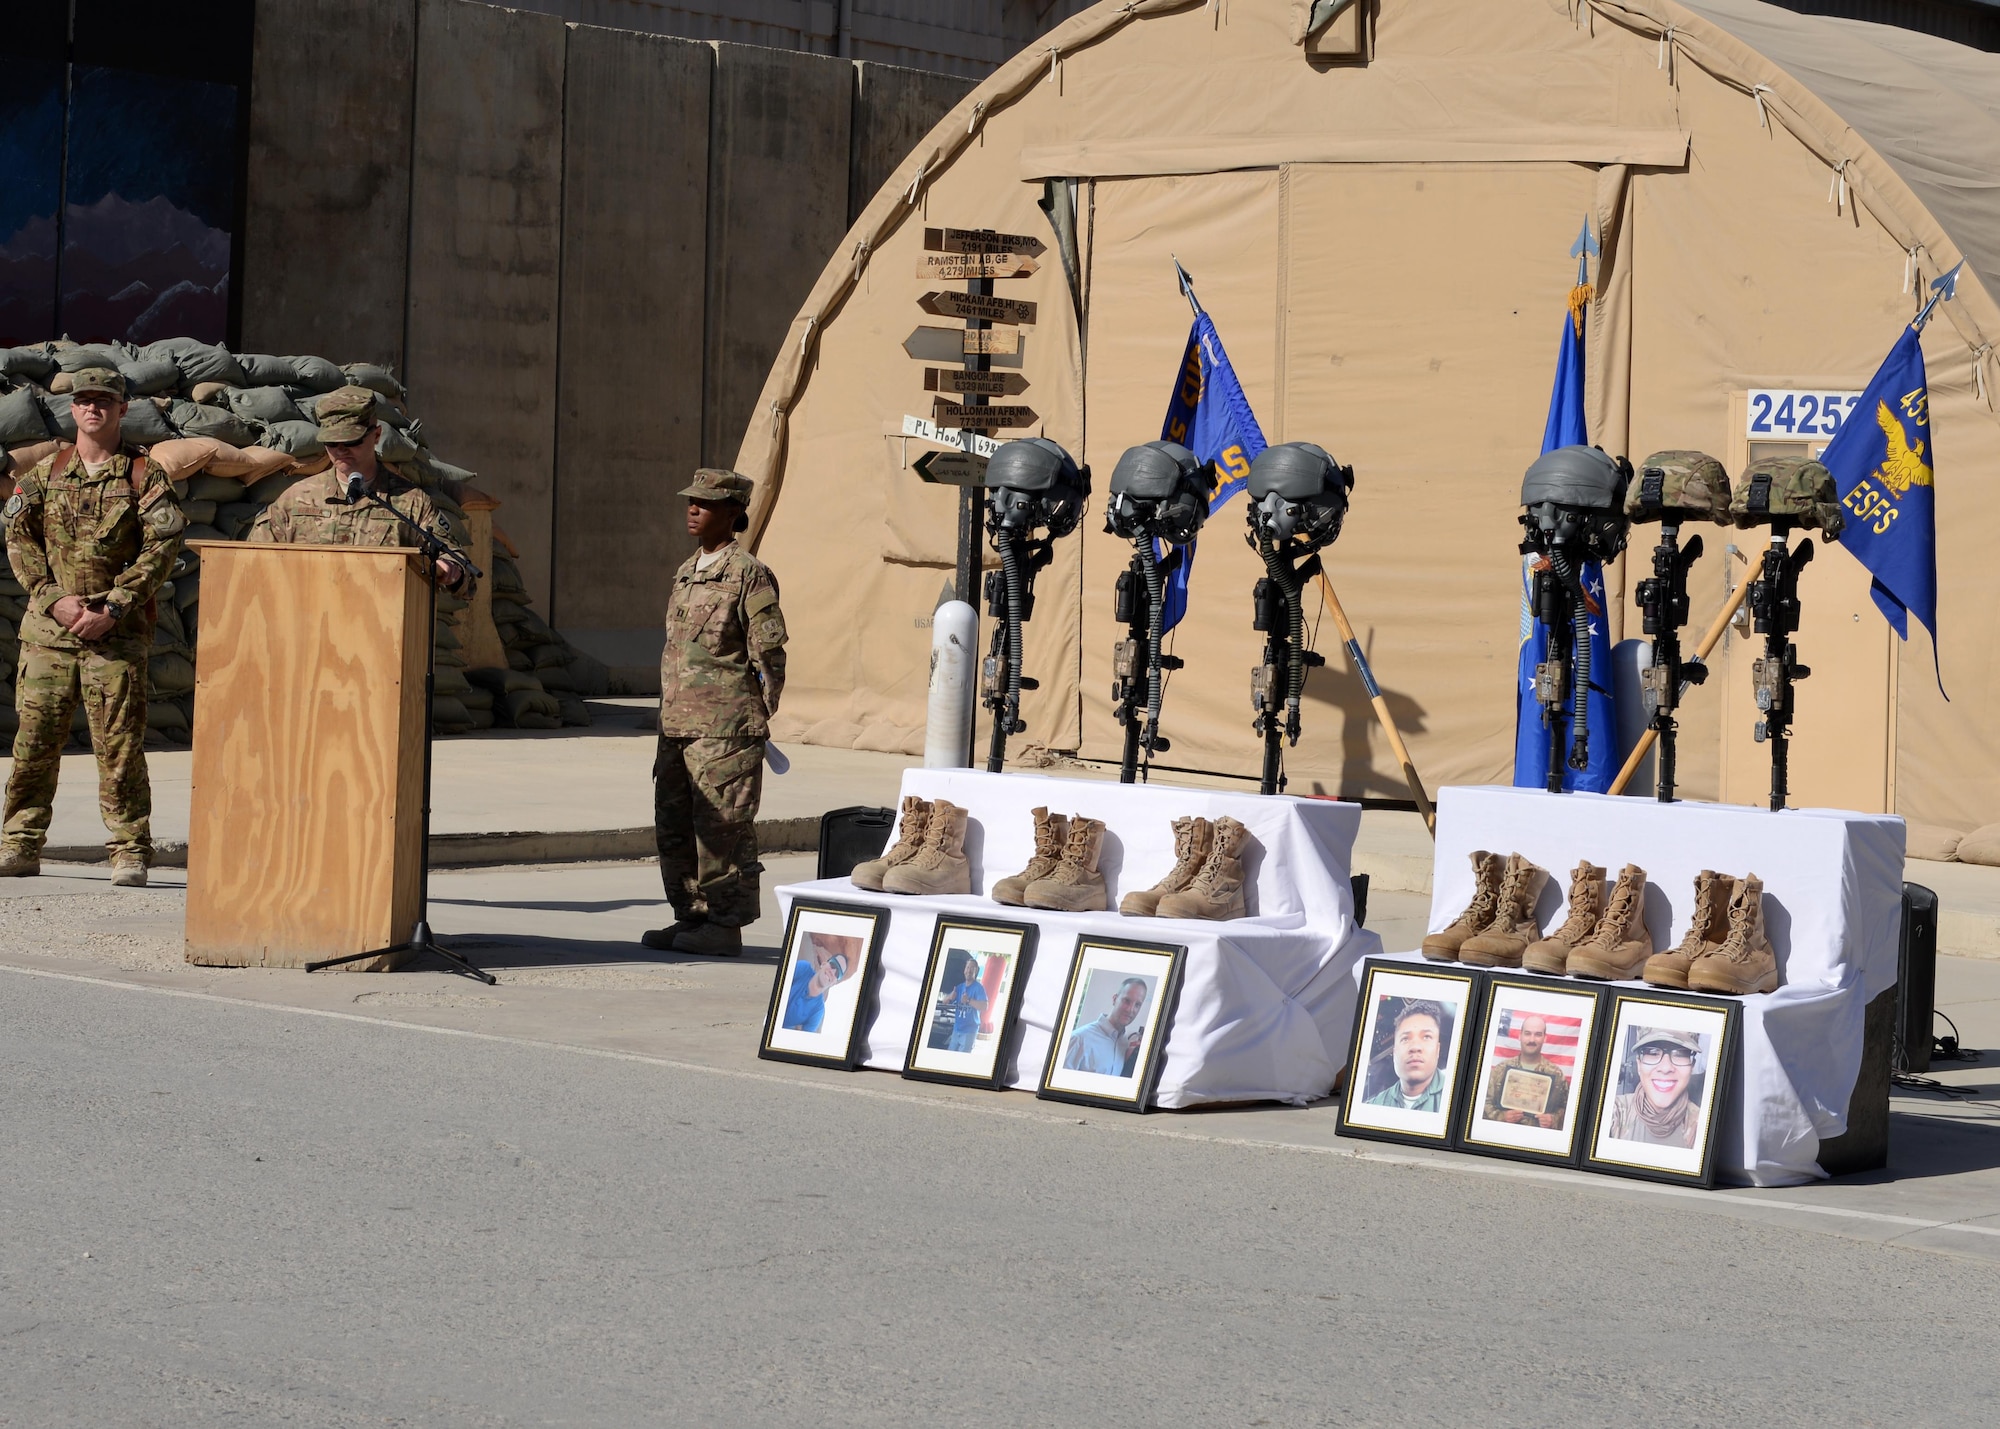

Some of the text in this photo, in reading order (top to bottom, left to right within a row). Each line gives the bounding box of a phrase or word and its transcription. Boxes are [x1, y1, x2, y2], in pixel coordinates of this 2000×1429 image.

[950, 230, 1038, 248] JEFFERSON BKS,MO
[985, 243, 1013, 254] MILES
[927, 254, 1008, 266] RAMSTEIN AB,GE
[938, 266, 995, 278] 4,279 MILES
[950, 292, 985, 306] HICKAM
[977, 306, 1005, 319] MILES
[977, 382, 1004, 393] MILES
[946, 406, 996, 416] HOLLOMAN
[914, 419, 929, 437] PL
[985, 417, 1013, 427] MILES
[1209, 444, 1251, 503] AS
[1842, 480, 1899, 535] ESFS
